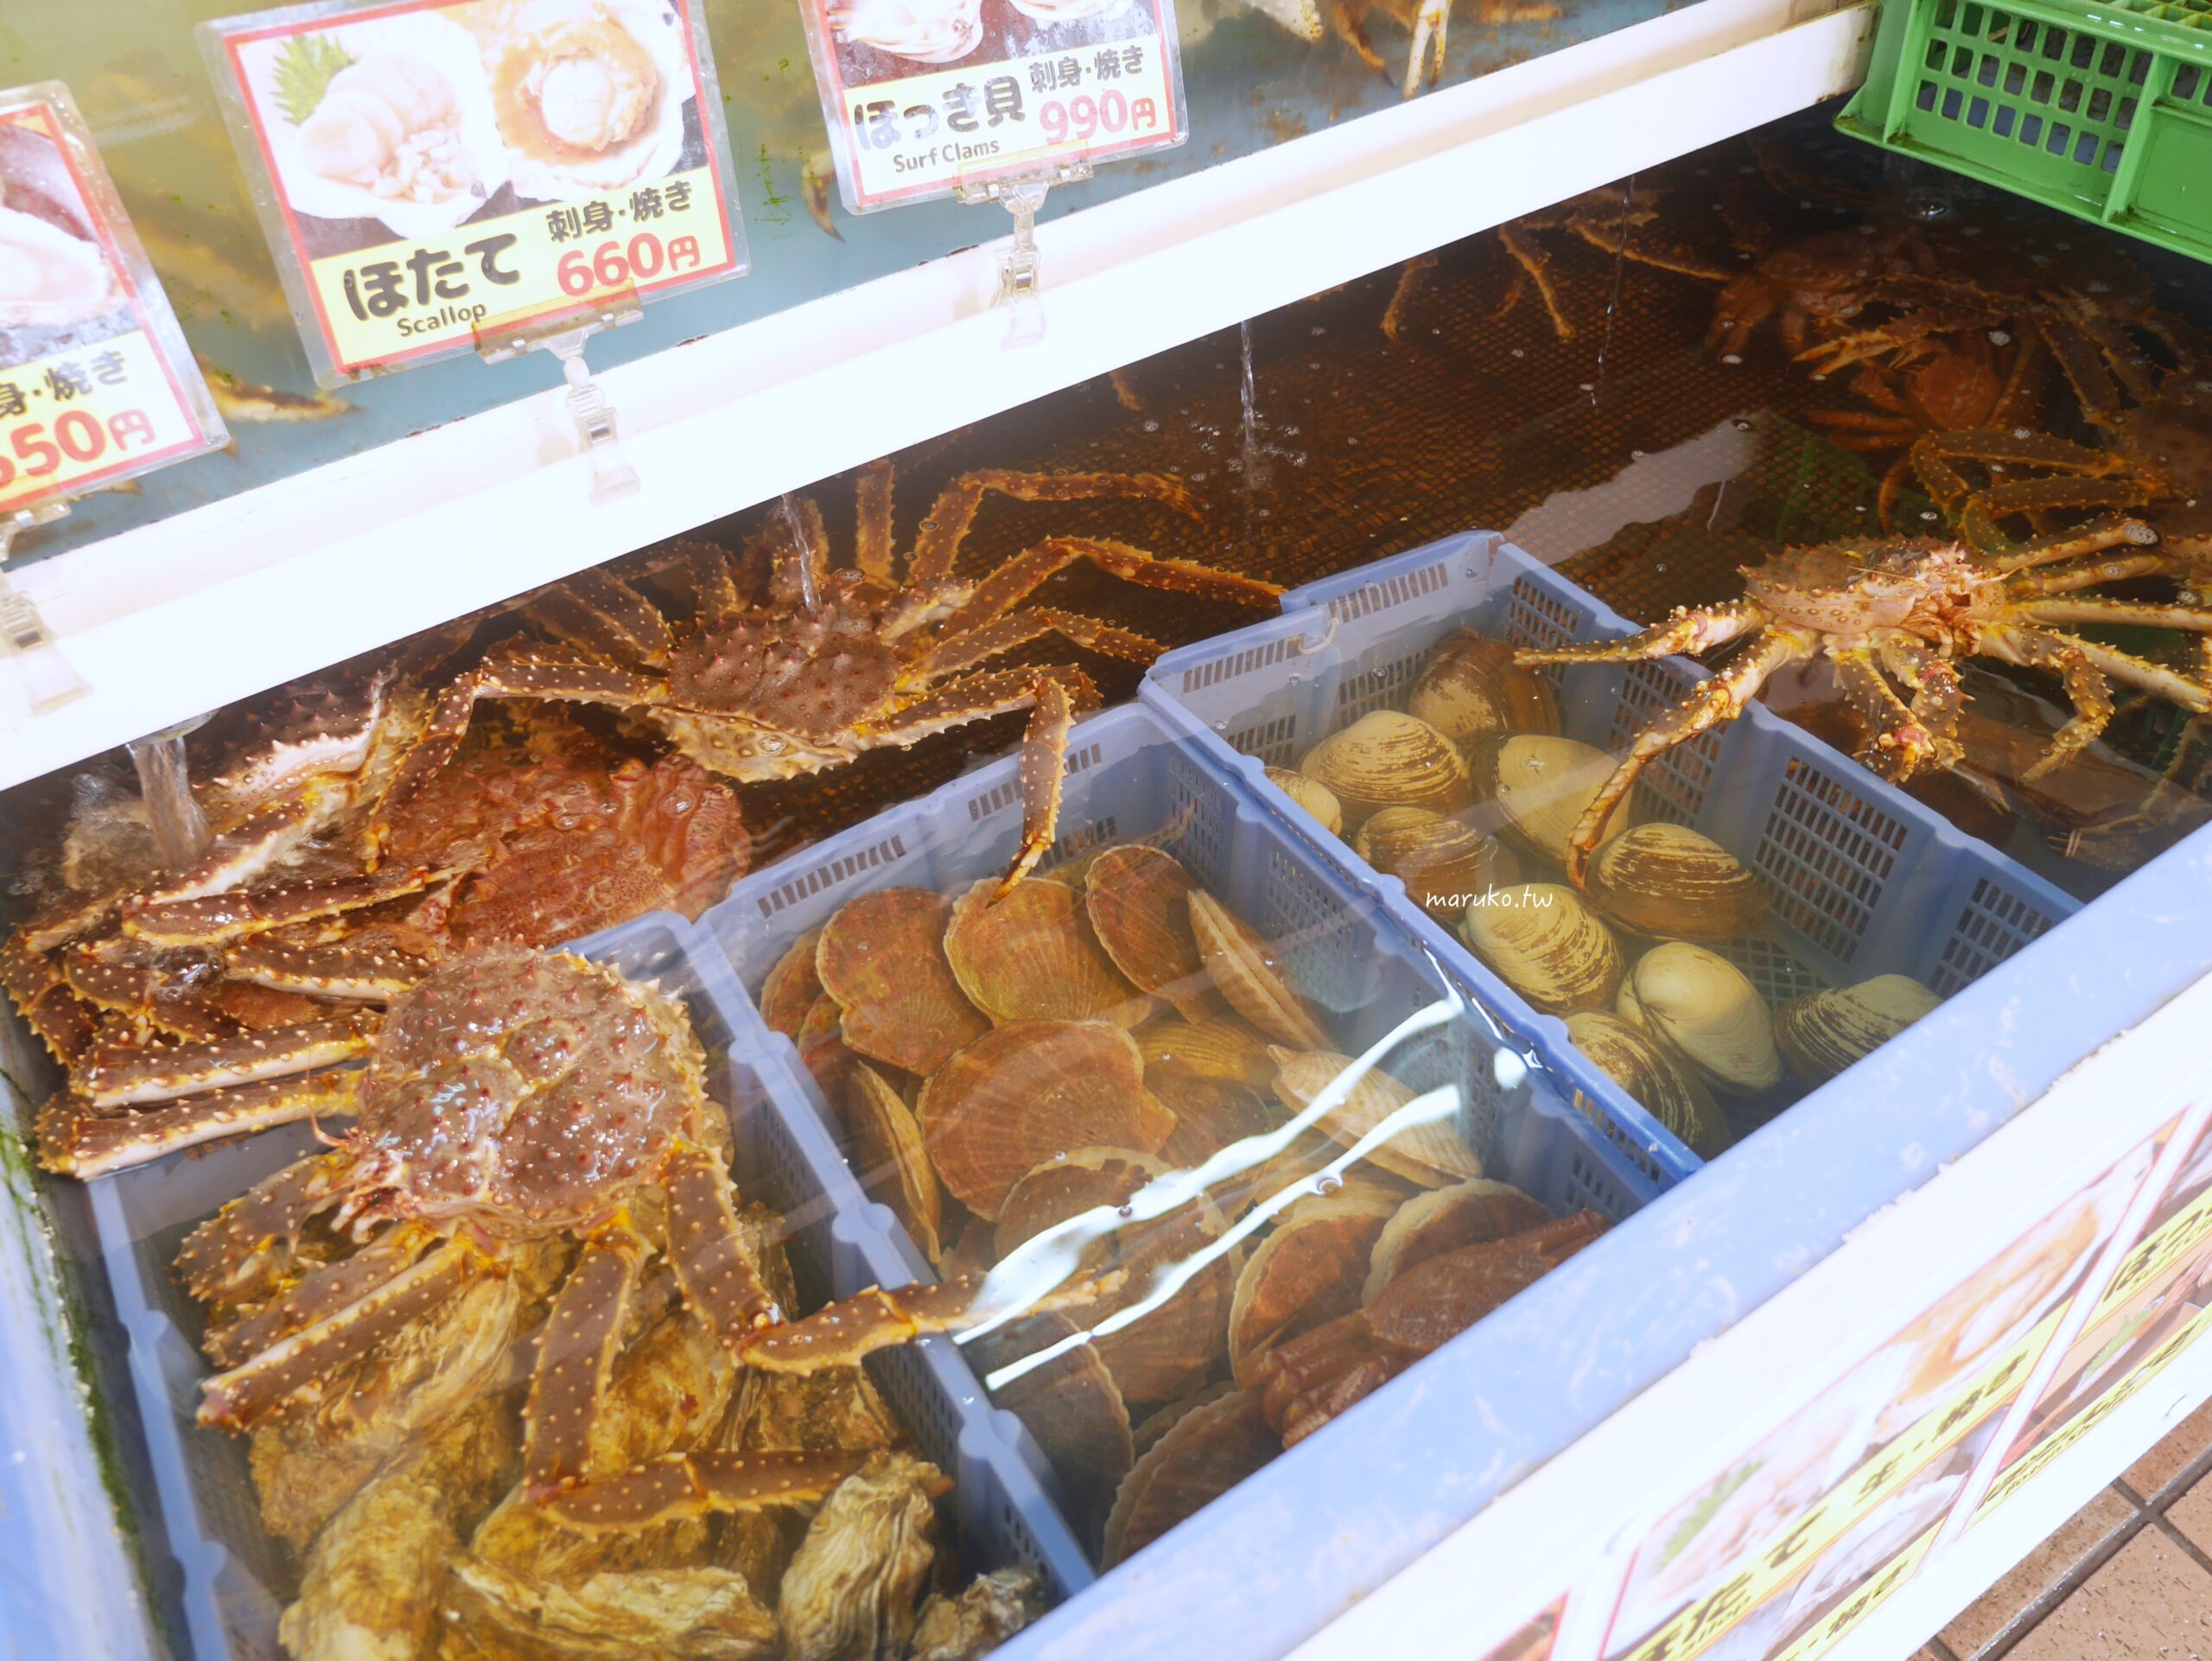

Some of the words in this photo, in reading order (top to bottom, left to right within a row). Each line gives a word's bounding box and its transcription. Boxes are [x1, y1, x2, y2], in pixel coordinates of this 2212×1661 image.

[1028, 44, 1144, 93] 刺身・焼き
[854, 75, 1027, 151] ほっき貝
[1039, 88, 1157, 146] 990円
[893, 149, 938, 174] Surf
[942, 138, 1001, 164] Clams
[544, 179, 692, 244] 刺身・焼き
[343, 232, 522, 322] ほたて
[556, 232, 702, 297] 660円
[397, 302, 487, 337] Scallop
